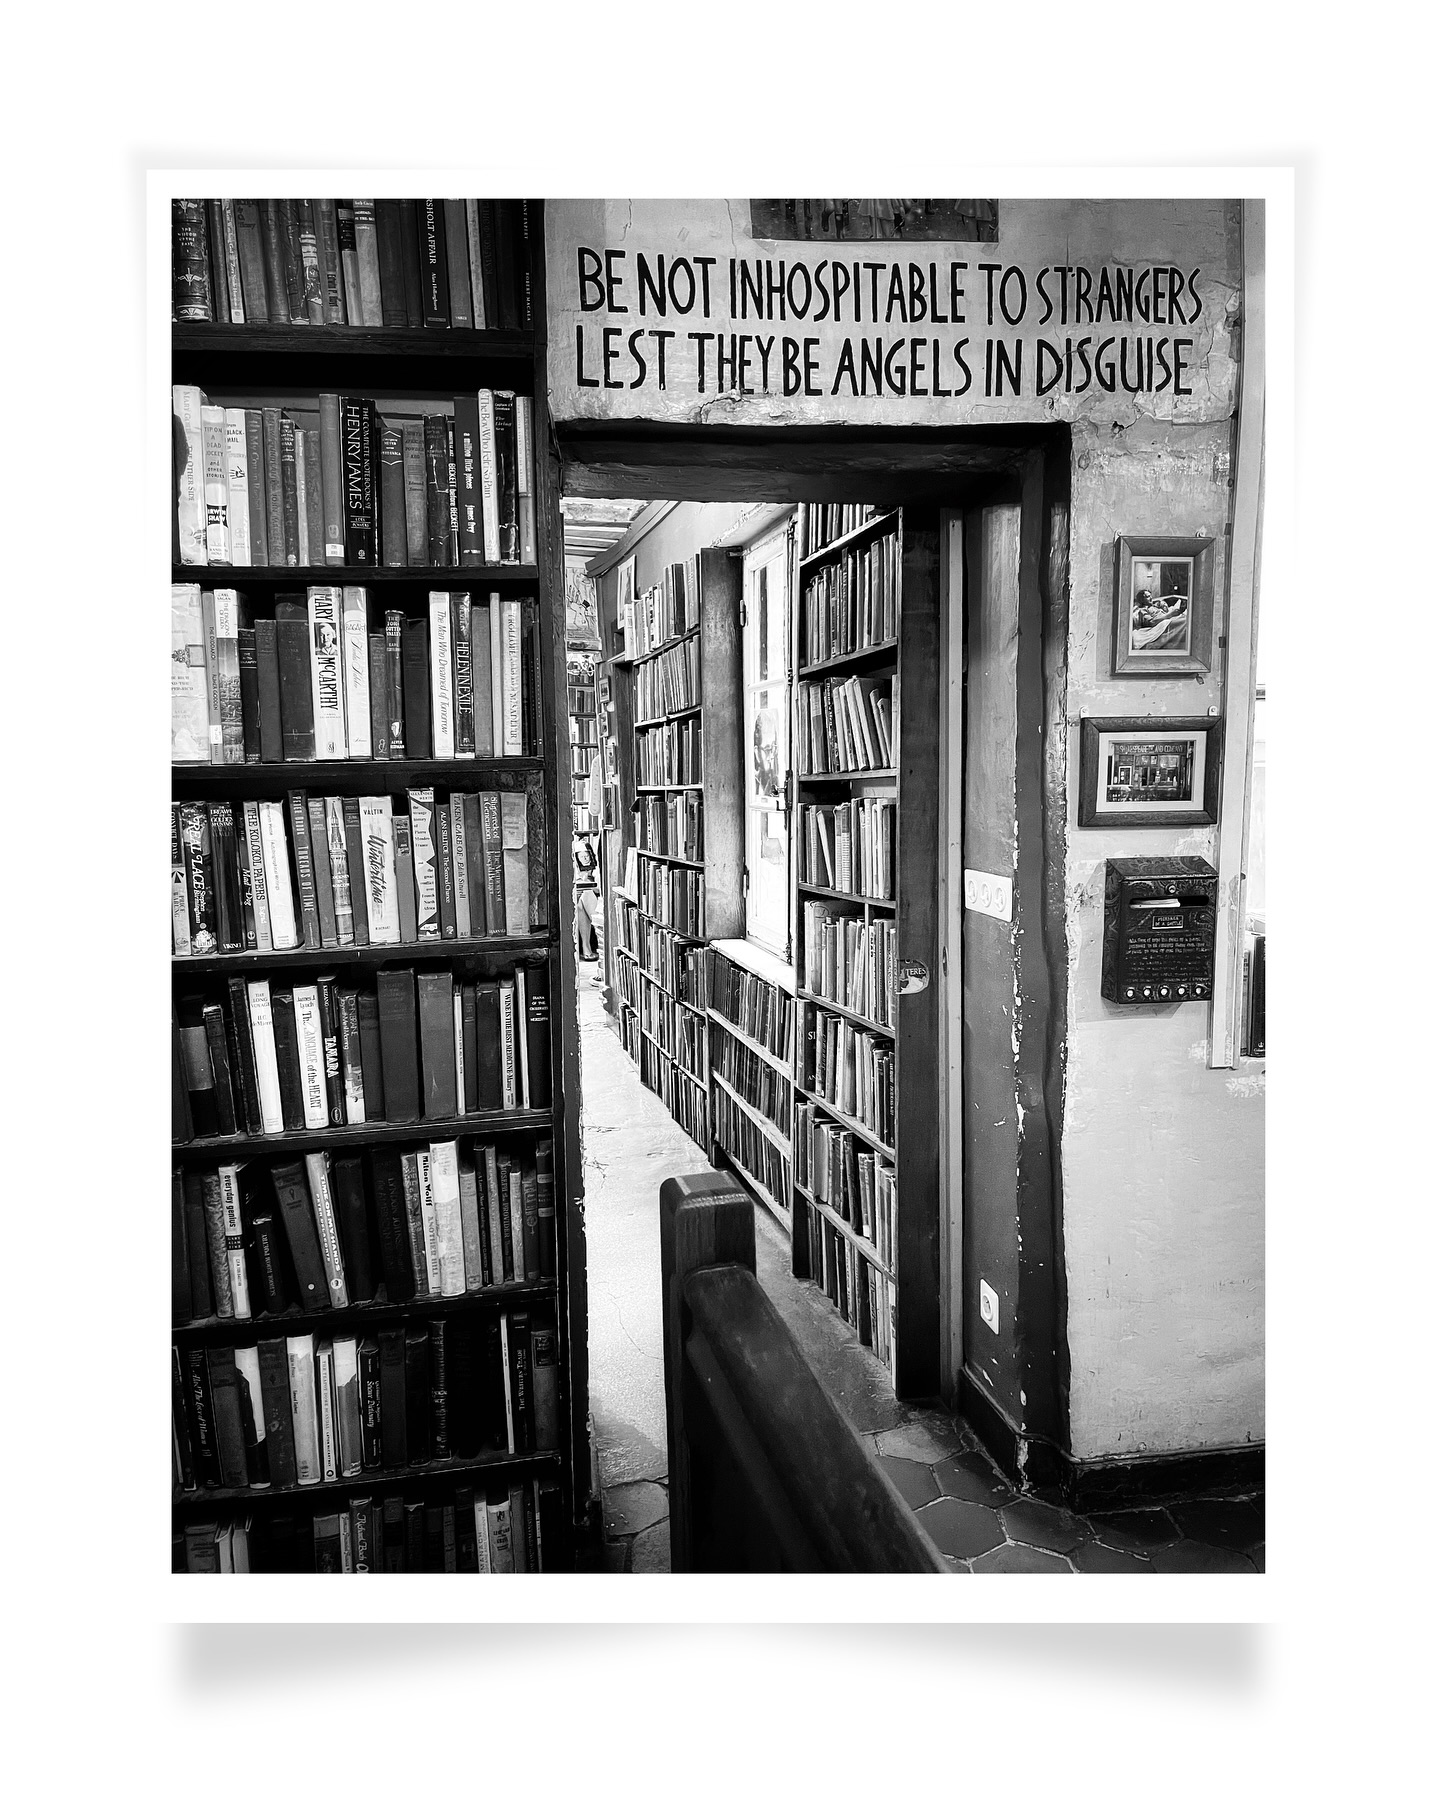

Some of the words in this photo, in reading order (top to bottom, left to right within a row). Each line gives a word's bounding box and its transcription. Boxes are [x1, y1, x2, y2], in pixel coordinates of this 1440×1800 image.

[427, 233, 437, 265] AFFAIR
[577, 246, 628, 314] BE
[637, 253, 716, 319] NOT
[730, 258, 967, 325] INHOSPITABLE
[978, 263, 1027, 327] TO
[1036, 265, 1203, 327] STRANGERS
[575, 326, 675, 391] LEST
[688, 331, 777, 399] THEY
[781, 336, 820, 396] BE
[831, 337, 972, 399] ANGELS
[984, 337, 1022, 397] IN
[1036, 337, 1193, 397] DISGUISE
[480, 396, 490, 413] The
[213, 426, 223, 434] ON
[346, 405, 361, 460] HENRY
[480, 413, 491, 429] Boy
[250, 435, 260, 451] My
[362, 421, 370, 457] COMPLETE
[463, 437, 472, 457] million
[483, 428, 493, 449] Who
[464, 458, 473, 472] little
[483, 449, 493, 466] Felt
[186, 460, 194, 485] OTHER
[363, 458, 372, 502] NOTEBOOKS
[448, 463, 456, 488] BECKETT
[463, 473, 474, 490] pieces
[187, 486, 195, 502] SIDE
[347, 461, 363, 509] JAMES
[483, 480, 493, 499] Pain
[449, 488, 457, 506] before
[449, 507, 459, 532] BECKETT
[465, 504, 475, 521] james
[466, 521, 476, 534] frey
[313, 593, 335, 621] MARY
[437, 610, 447, 624] The
[438, 624, 448, 640] Man
[438, 641, 449, 658] Who
[456, 641, 471, 675] HELEN
[439, 659, 450, 691] Dreamed
[457, 675, 471, 688] IN
[438, 691, 450, 700] of
[458, 688, 472, 715] EXILE
[440, 701, 451, 735] Tomorrow
[246, 807, 258, 828] THE
[453, 795, 462, 822] TAKEN
[483, 802, 492, 840] Generation
[187, 817, 202, 854] REAL
[441, 829, 449, 855] SILLITOE
[454, 823, 463, 845] CARE
[249, 829, 262, 867] KOLOKOL
[456, 846, 464, 857] OF
[190, 854, 205, 890] LACE
[297, 845, 311, 878] THREADS
[367, 834, 388, 904] Wintertime
[242, 868, 252, 886] Mad
[252, 867, 266, 901] PAPERS
[301, 881, 312, 890] OF
[443, 866, 451, 885] Second
[198, 890, 206, 912] Stephen
[303, 894, 315, 912] TIME
[444, 884, 452, 903] Chance
[193, 889, 202, 924] Birmingham
[504, 994, 512, 1011] WINE
[505, 1017, 513, 1030] THE
[505, 1030, 513, 1044] BEST
[324, 1035, 340, 1079] TAMARA
[307, 1064, 318, 1074] of
[307, 1072, 317, 1084] the
[308, 1084, 322, 1109] HEART
[422, 1155, 431, 1183] Milton
[223, 1175, 237, 1204] everyday
[320, 1174, 329, 1201] TIME
[423, 1184, 432, 1207] Wolff
[225, 1205, 238, 1228] genius
[325, 1201, 332, 1217] ON
[501, 1202, 511, 1238] PROVIDER
[315, 1193, 323, 1217] PETER
[319, 1218, 331, 1263] DELACORTE
[327, 1218, 334, 1234] MY
[427, 1216, 437, 1256] ANOTHER
[261, 1233, 271, 1256] POETRY
[330, 1236, 341, 1272] HANDS
[430, 1258, 439, 1277] HILL
[355, 1512, 367, 1542] Richard
[358, 1541, 368, 1561] Bach
